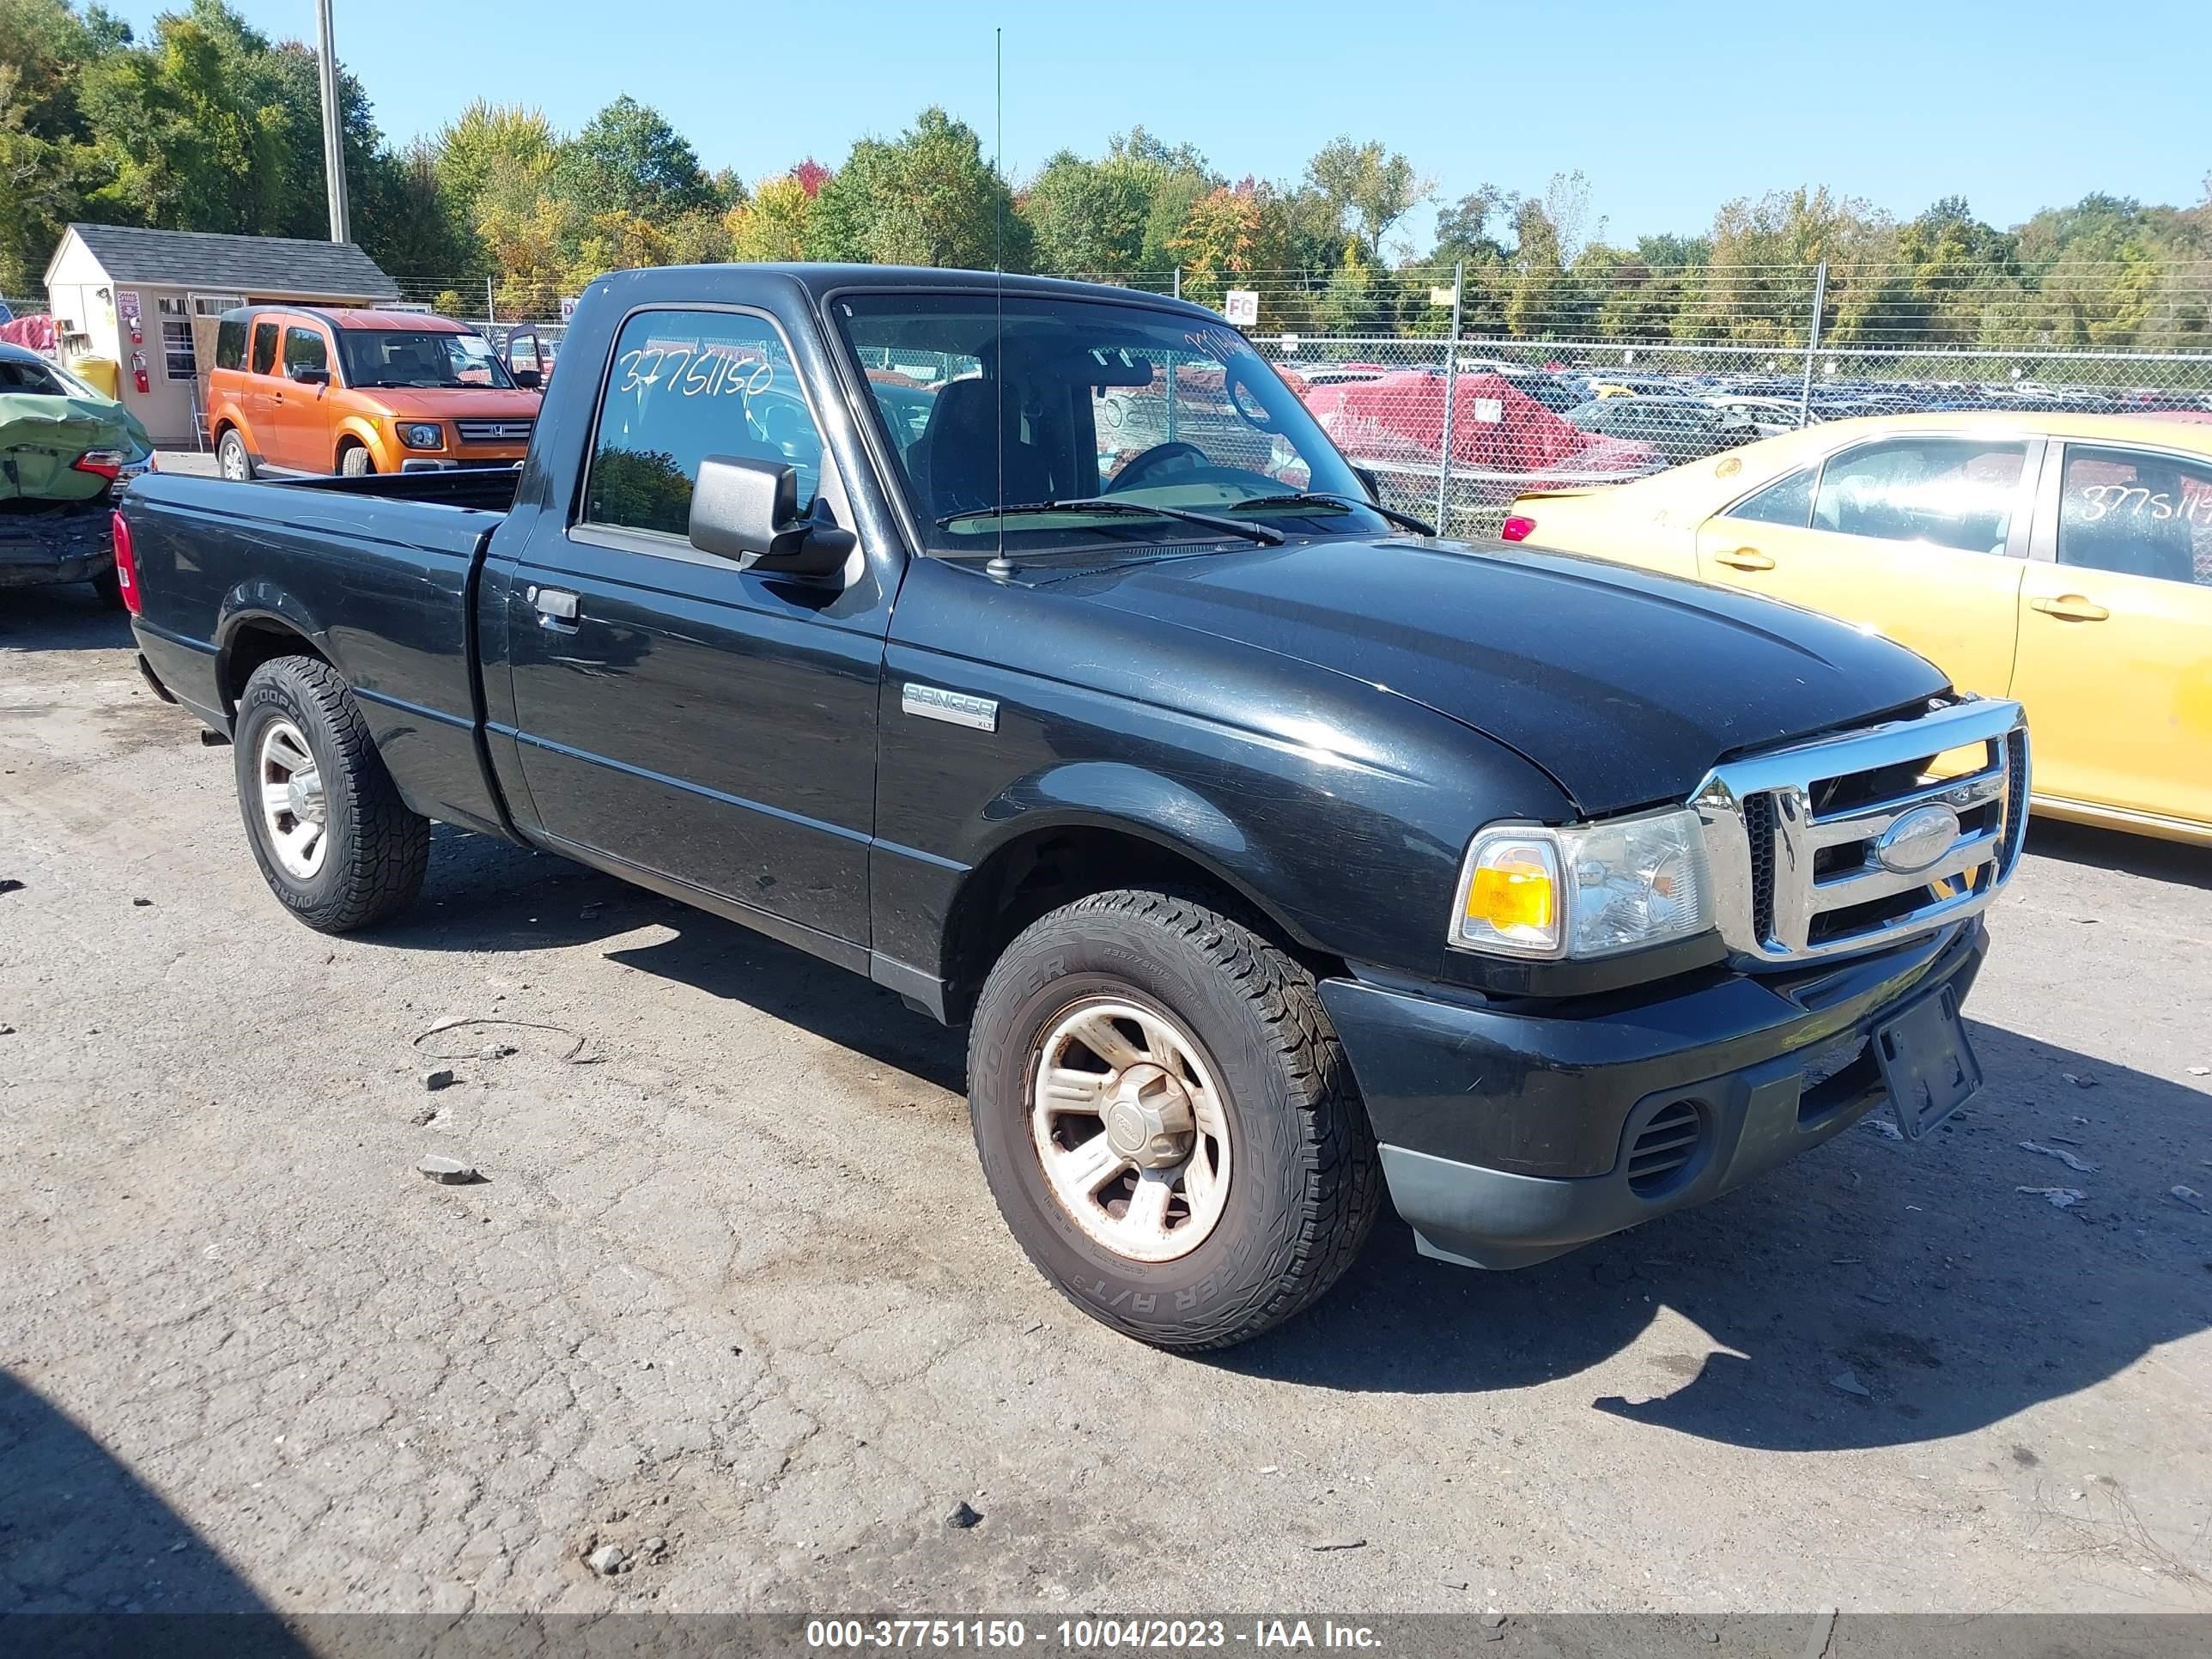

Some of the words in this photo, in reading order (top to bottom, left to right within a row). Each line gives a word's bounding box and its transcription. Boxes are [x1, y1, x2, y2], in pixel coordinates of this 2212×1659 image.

[1230, 299, 1254, 316] FG
[619, 349, 774, 397] 37751150
[252, 690, 308, 734] COOPER
[904, 686, 996, 719] RANGER
[977, 720, 993, 730] XLT
[984, 954, 1068, 1106] COOPER
